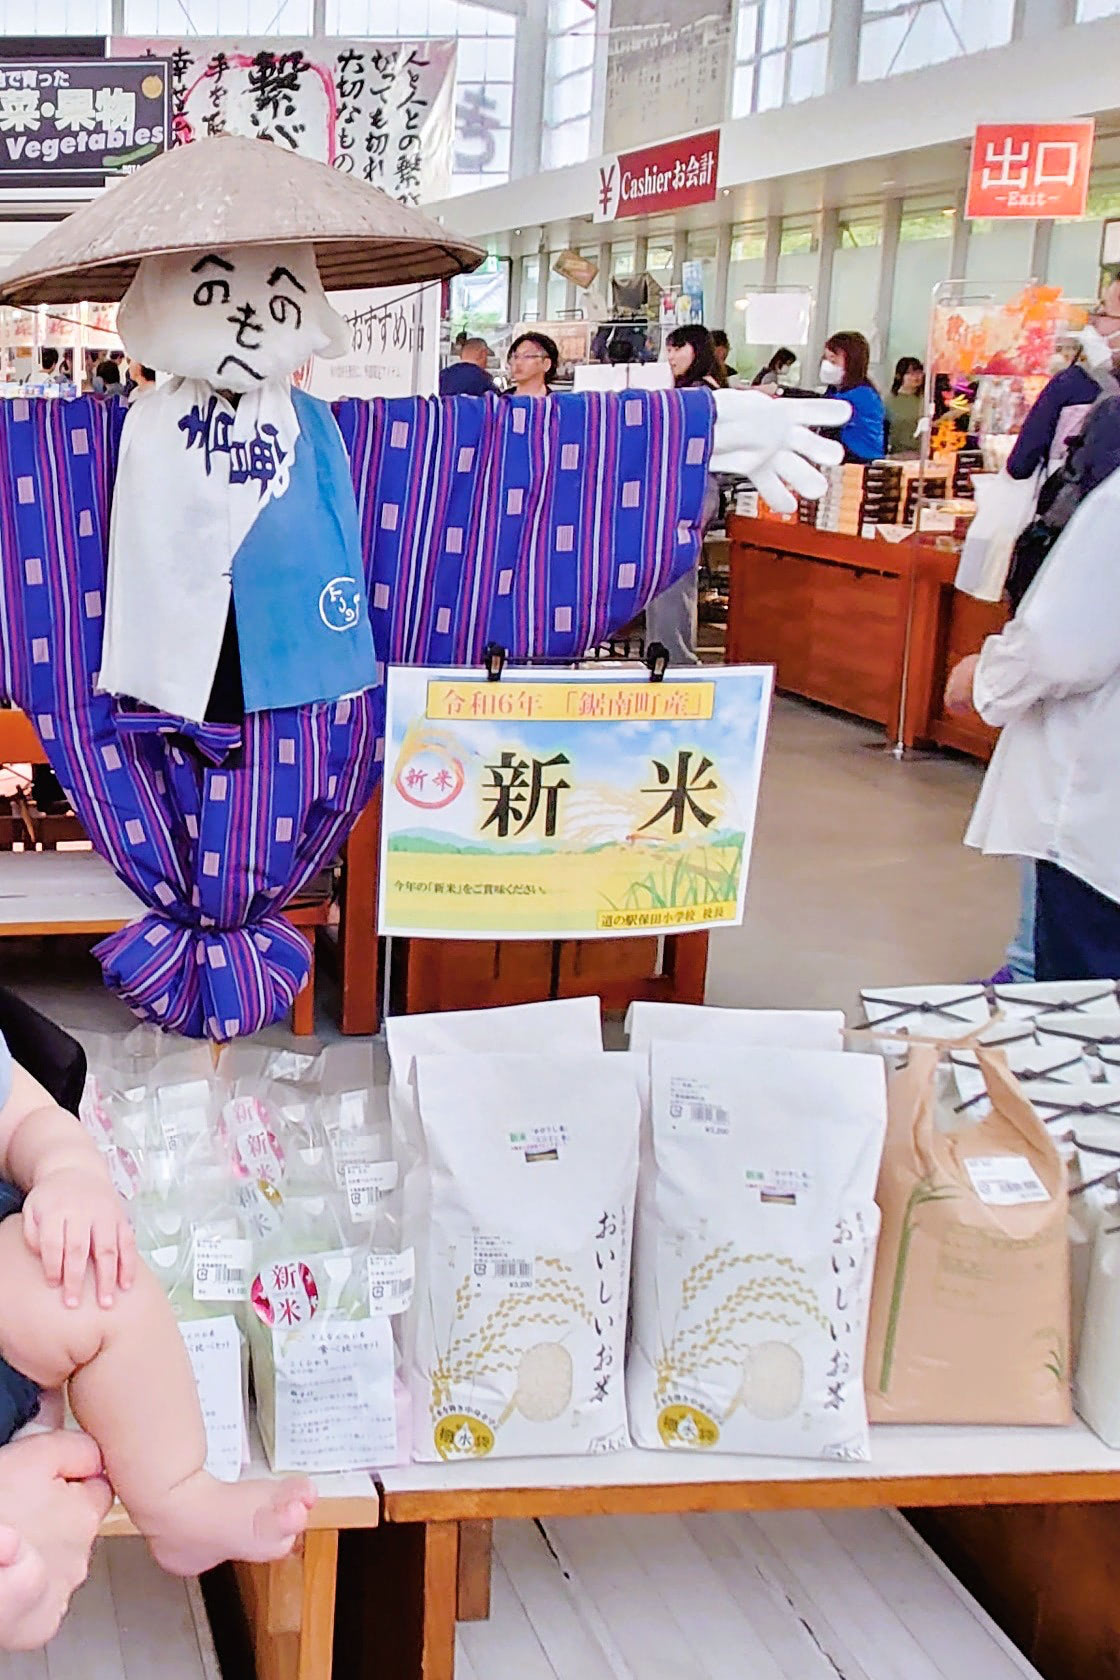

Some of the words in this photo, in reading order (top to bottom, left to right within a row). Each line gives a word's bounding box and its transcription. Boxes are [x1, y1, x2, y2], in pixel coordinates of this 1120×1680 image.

[333, 48, 365, 174] 大切なもの
[364, 49, 398, 193] 切っても切れ
[6, 126, 164, 162] Vegetables
[981, 136, 1079, 190] 出口
[621, 164, 673, 201] Cashier
[672, 151, 714, 191] お会計
[344, 305, 424, 354] おすすめ品
[443, 688, 544, 717] 令和6年
[564, 689, 703, 718] 「鋸南町産」
[405, 766, 454, 793] 新米
[480, 749, 719, 838] 新米
[271, 1262, 301, 1326] 新米
